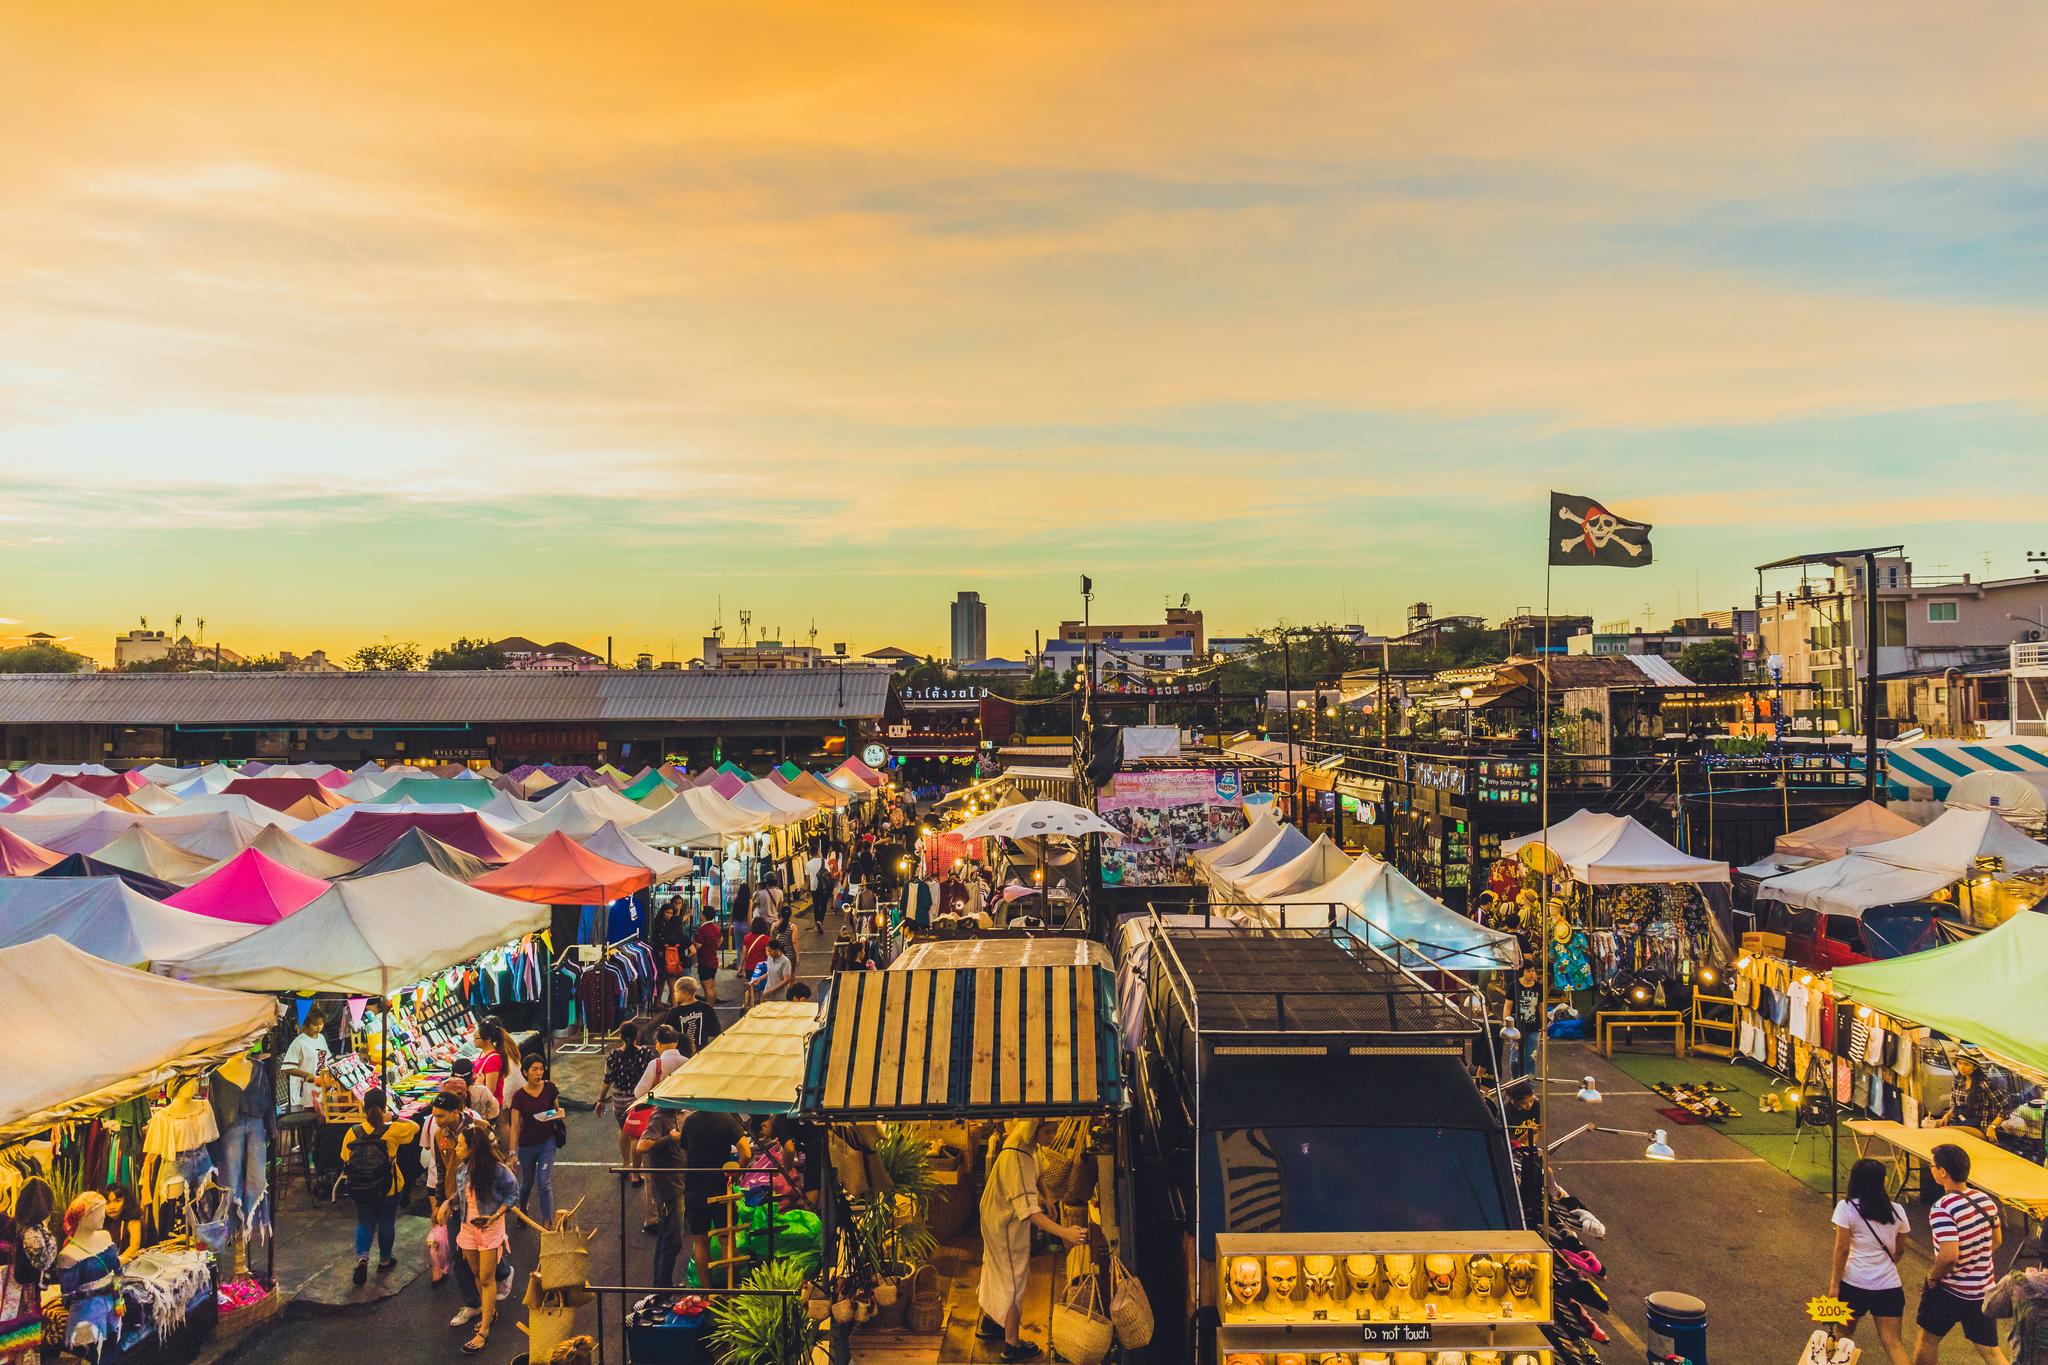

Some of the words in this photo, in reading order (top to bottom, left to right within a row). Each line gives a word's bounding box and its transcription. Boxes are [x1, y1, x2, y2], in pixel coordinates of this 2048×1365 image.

[1791, 716, 1813, 730] Little
[1364, 1327, 1377, 1340] Do
[1382, 1325, 1401, 1340] not
